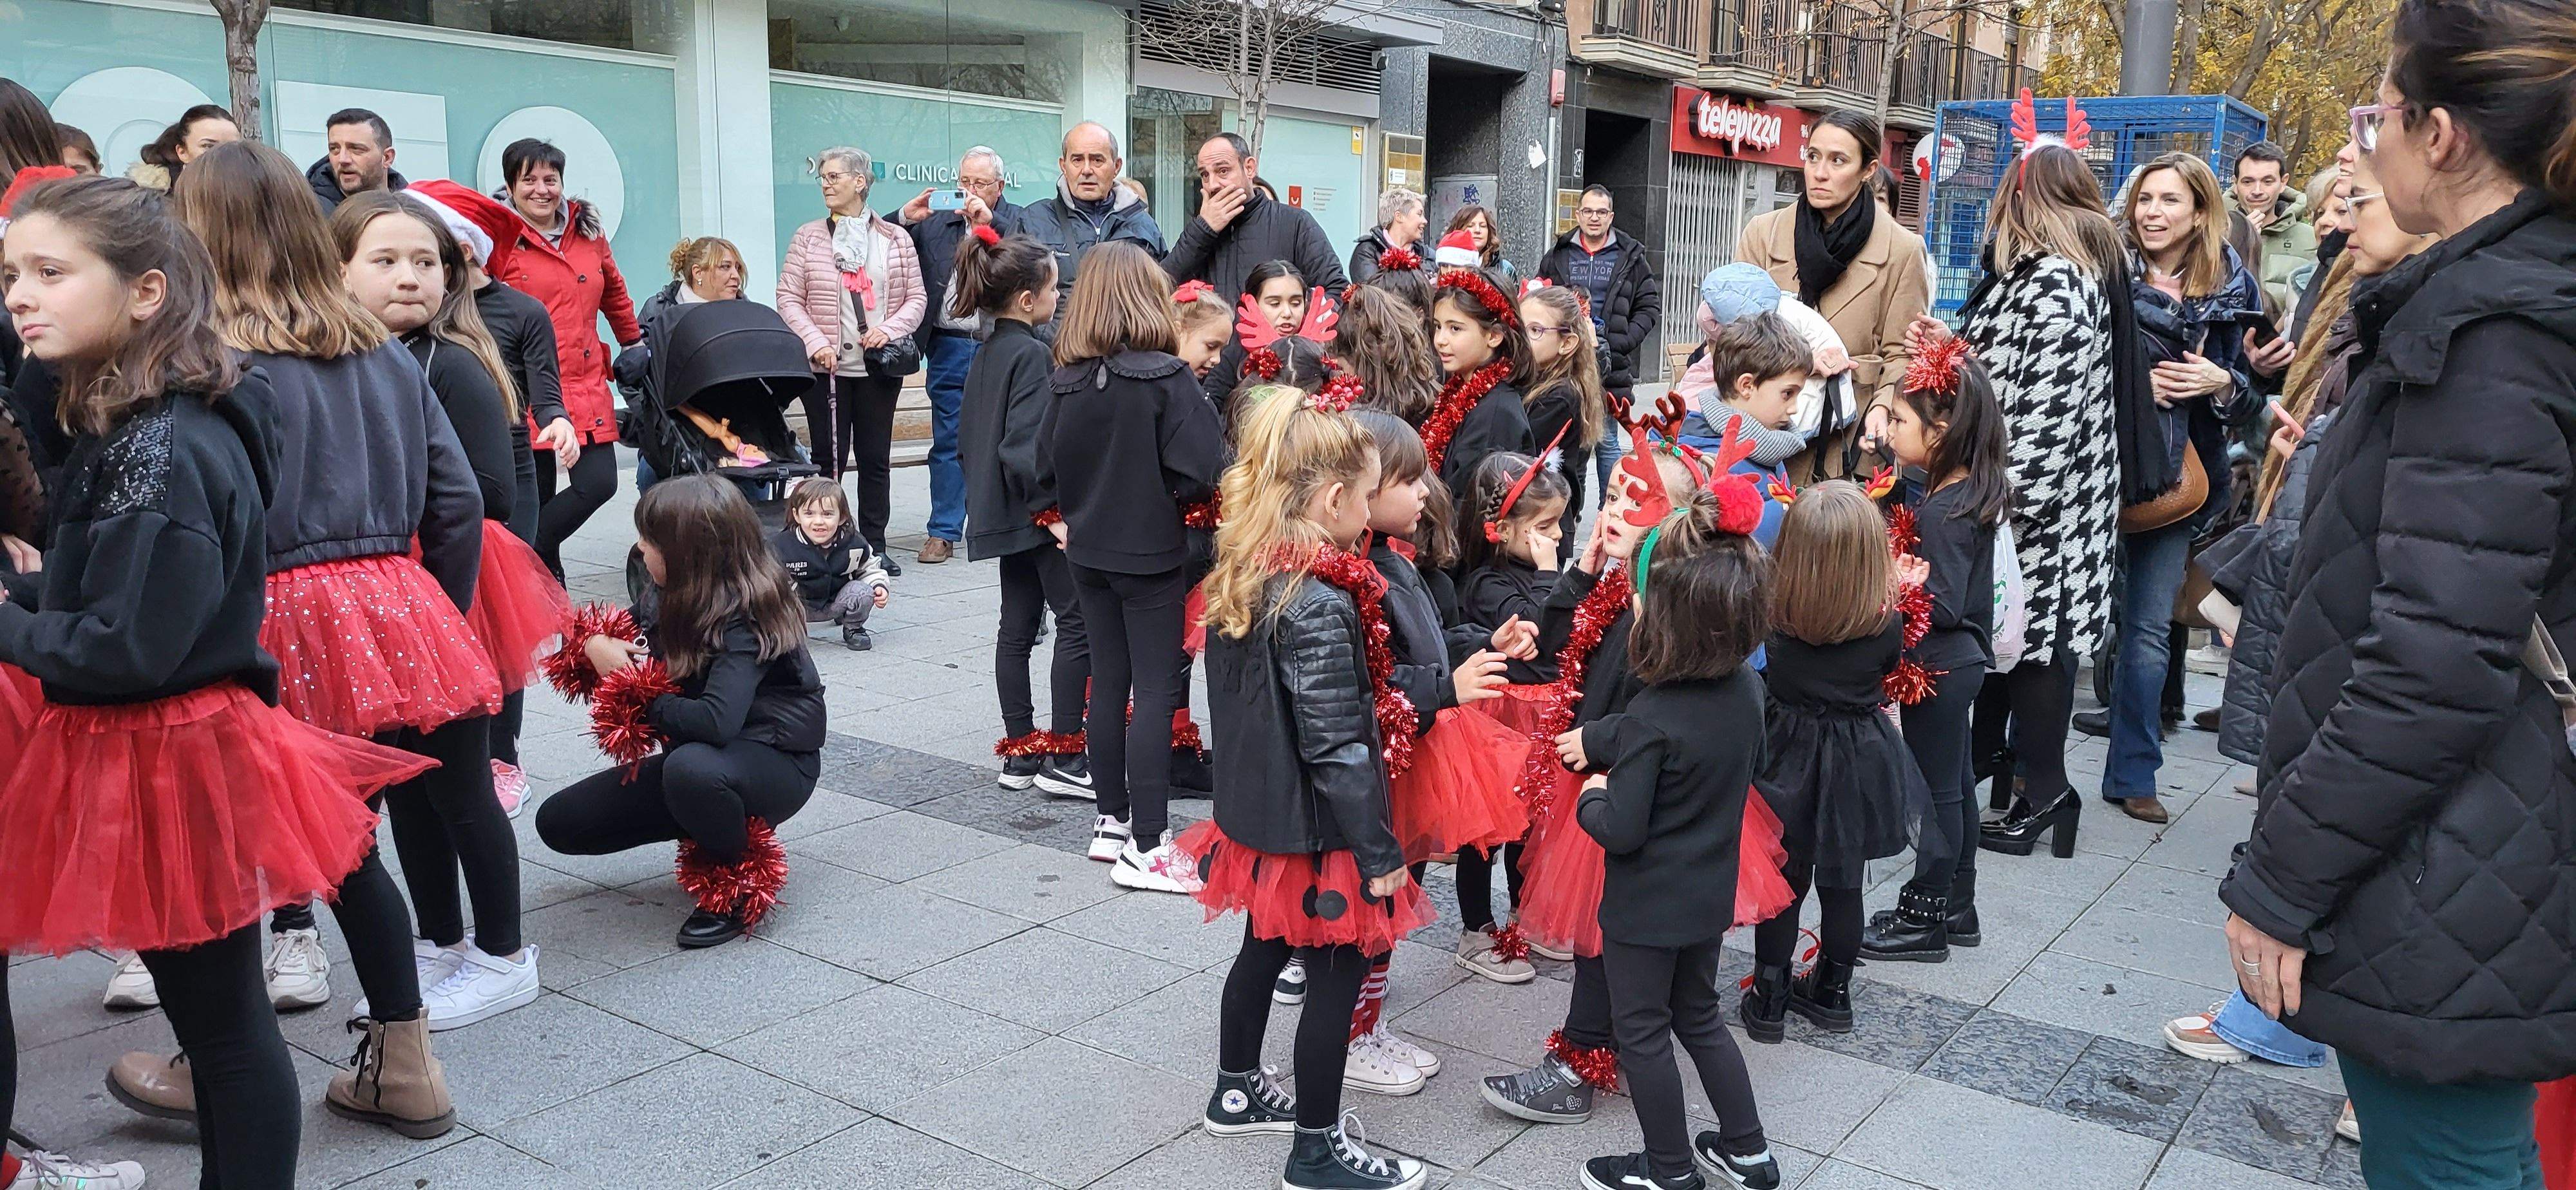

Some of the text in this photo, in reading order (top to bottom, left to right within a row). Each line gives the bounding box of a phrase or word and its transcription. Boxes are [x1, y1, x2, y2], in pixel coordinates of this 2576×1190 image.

[1699, 94, 1782, 156] telepizza
[896, 164, 959, 184] CLINICA
[1569, 266, 1613, 276] EW YOR
